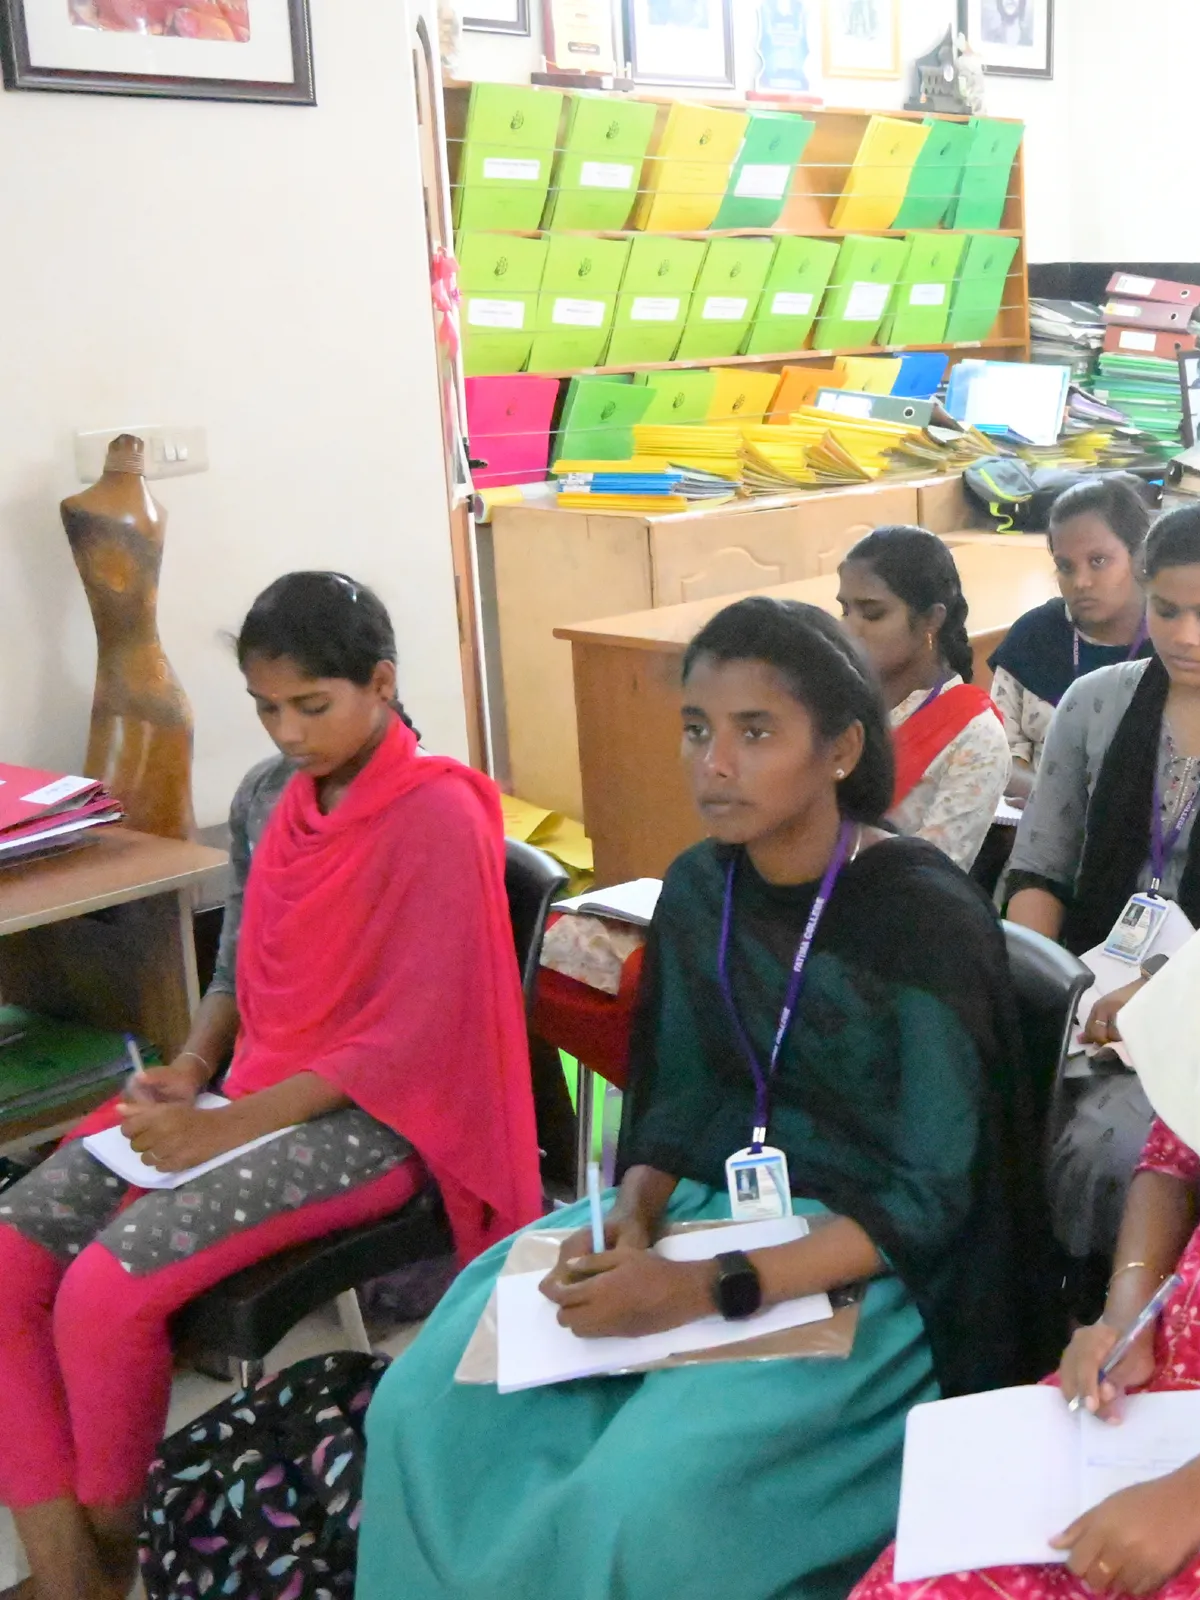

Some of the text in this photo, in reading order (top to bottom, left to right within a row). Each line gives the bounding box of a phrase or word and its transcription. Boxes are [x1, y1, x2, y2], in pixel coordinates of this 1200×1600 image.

[1175, 800, 1193, 831] COLLEGE
[793, 896, 825, 972] FATIMA COLLEGE
